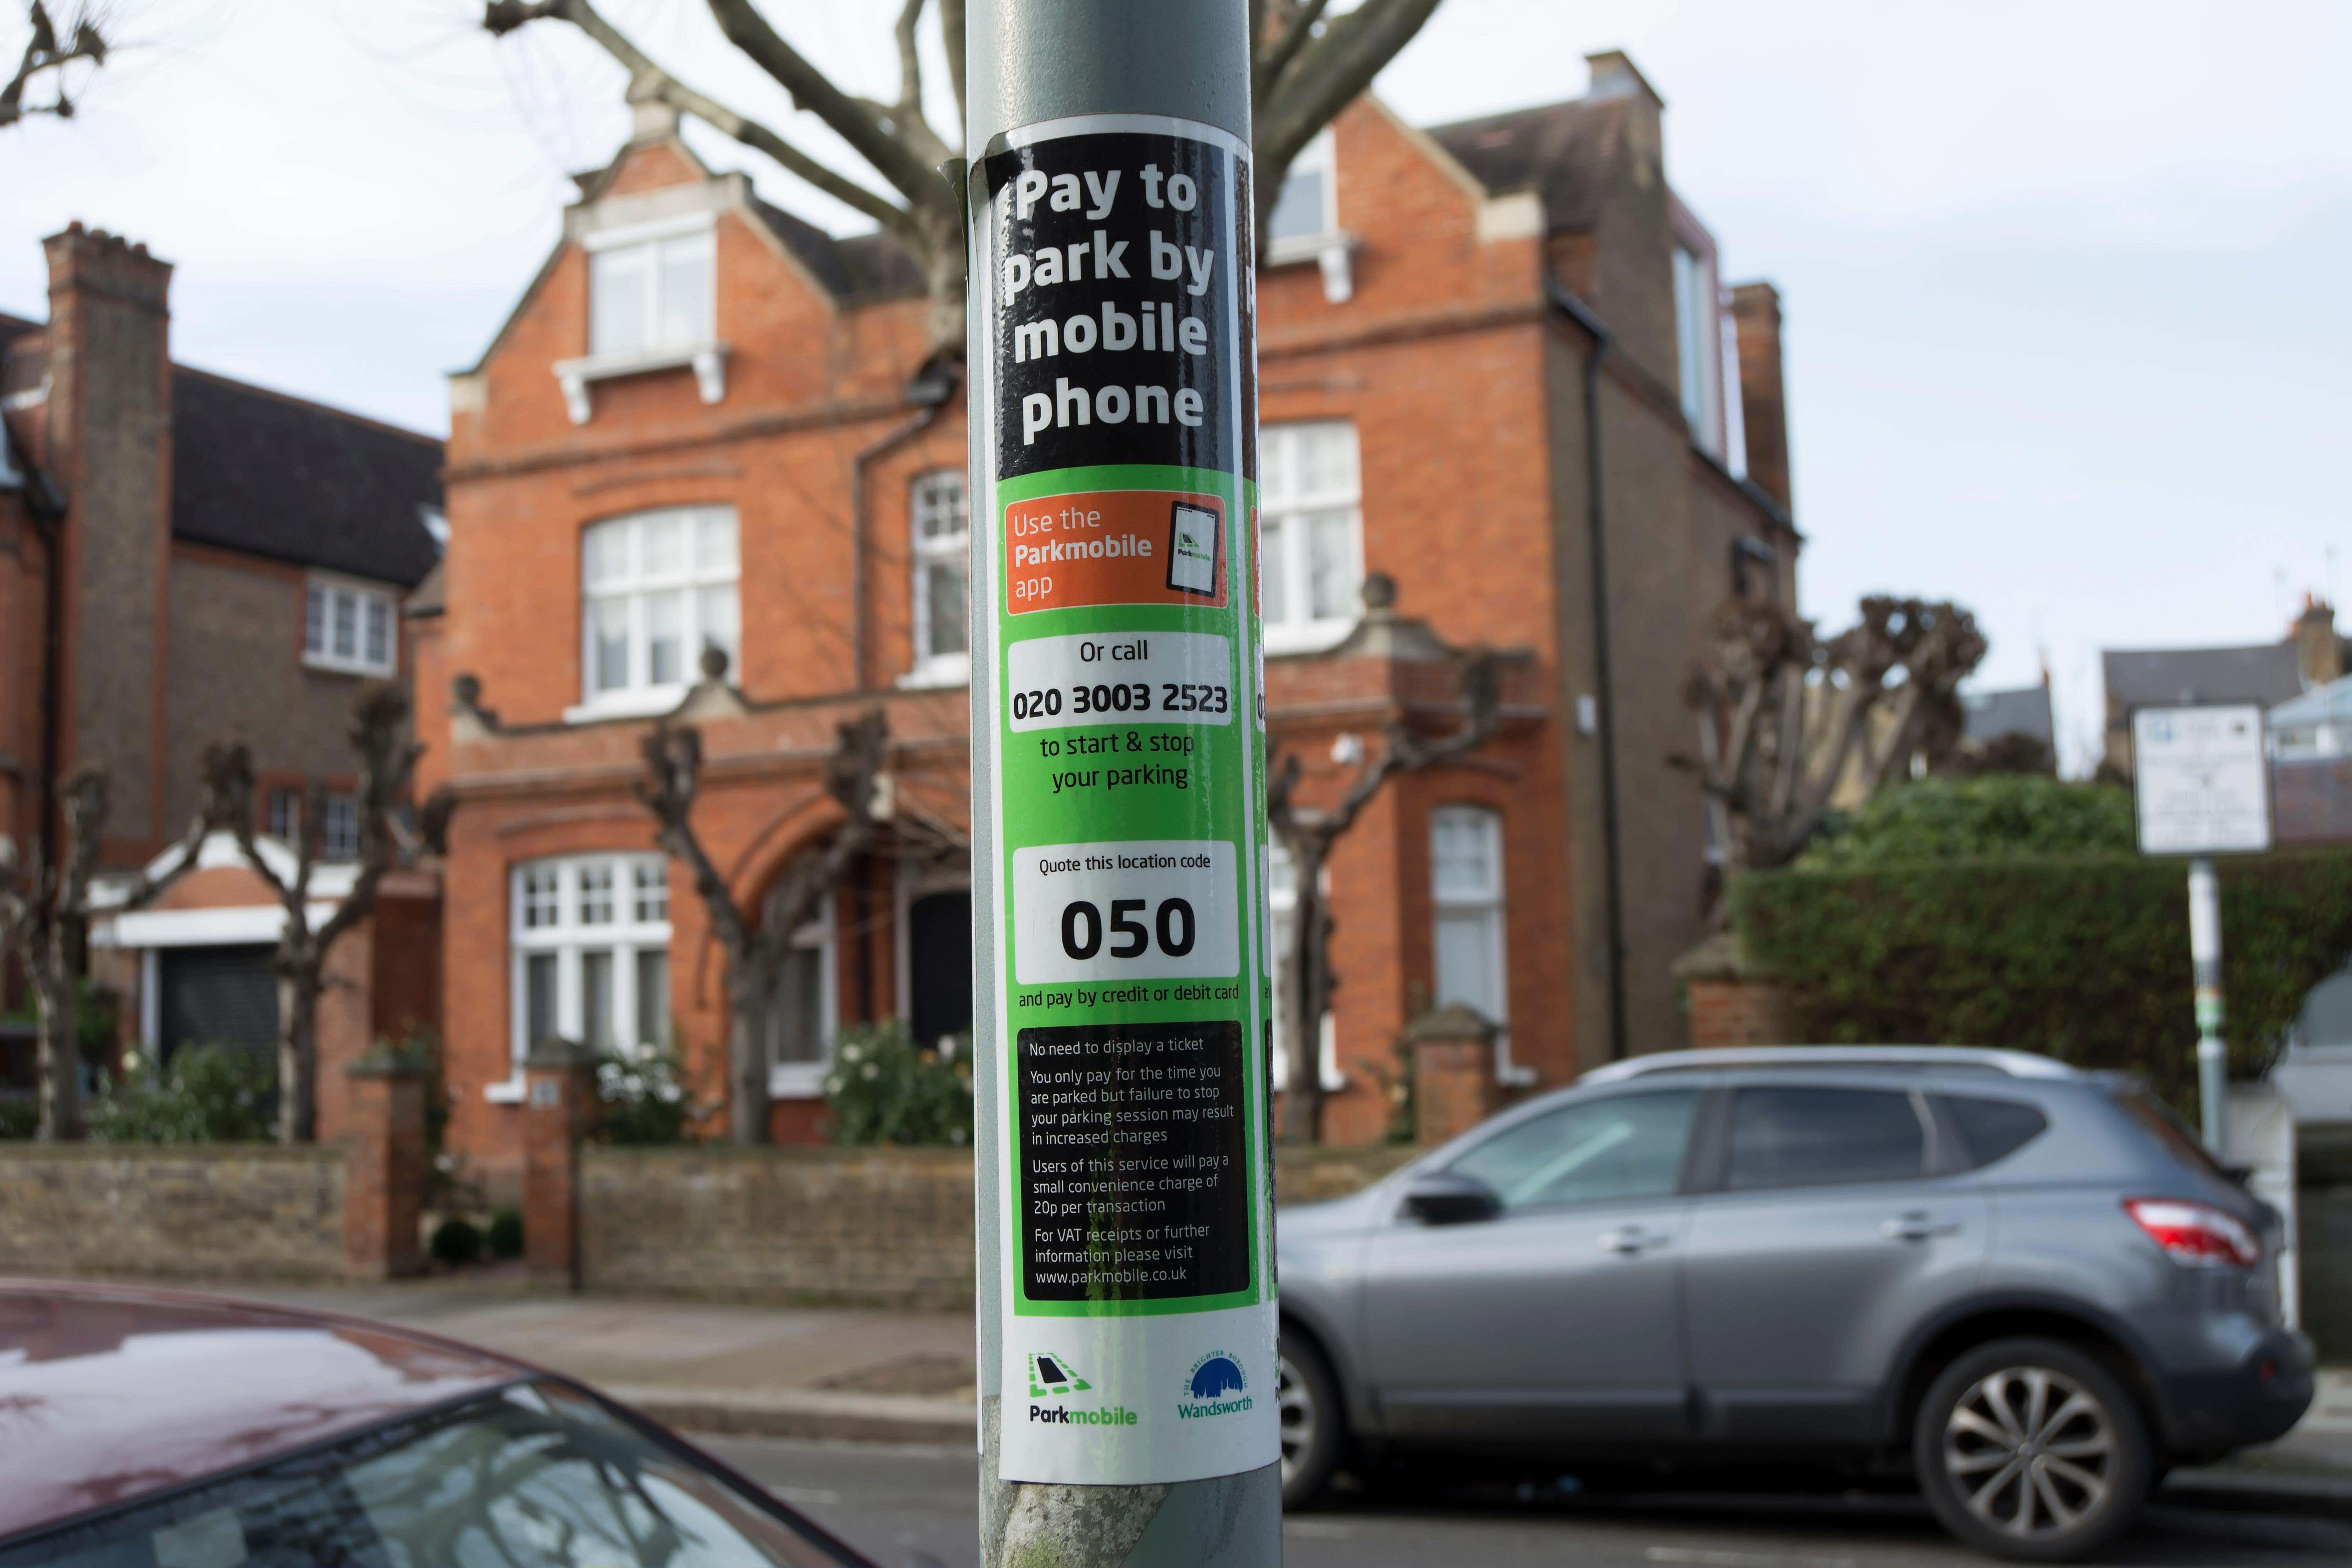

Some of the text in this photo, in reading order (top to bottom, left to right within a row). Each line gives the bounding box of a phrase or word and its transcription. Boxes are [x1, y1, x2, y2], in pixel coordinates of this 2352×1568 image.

[1016, 163, 1197, 220] Pay to
[1004, 230, 1131, 306] park
[1150, 230, 1214, 297] by
[1015, 301, 1207, 363] mobile
[1023, 378, 1203, 445] phone
[1014, 507, 1101, 537] Use the
[1015, 534, 1152, 567] Parkmobile
[1178, 548, 1210, 561] Parkmobile
[1016, 577, 1053, 601] app
[1080, 641, 1147, 662] Or call
[1013, 684, 1228, 720] 020 3003 2523
[1040, 732, 1194, 757] to start & stop
[1052, 764, 1188, 793] your parking
[1040, 854, 1210, 876] Quote this location code
[1061, 898, 1195, 960] 050
[1019, 984, 1238, 1008] and pay by credit or debit card
[1029, 1036, 1204, 1056] No need to display a ticket
[1031, 1065, 1221, 1085] You only pay for the time you
[1031, 1085, 1219, 1106] are parked but failure to stop
[1031, 1104, 1234, 1127] your parking session may result
[1033, 1129, 1167, 1145] in increased charges
[1033, 1155, 1229, 1173] Users of this service will pay a
[1033, 1174, 1218, 1194] small convenience charge of
[1034, 1198, 1165, 1216] 20p per transaction
[1035, 1224, 1210, 1242] For VAT receipts or further
[1035, 1245, 1192, 1264] information please visit
[1036, 1265, 1187, 1285] www.parkmobile.co.uk
[1190, 1350, 1224, 1373] BRIGHTER
[1229, 1352, 1248, 1388] BOROUGH
[1030, 1405, 1137, 1425] Parkmobile
[1177, 1396, 1252, 1419] Wandsworth
